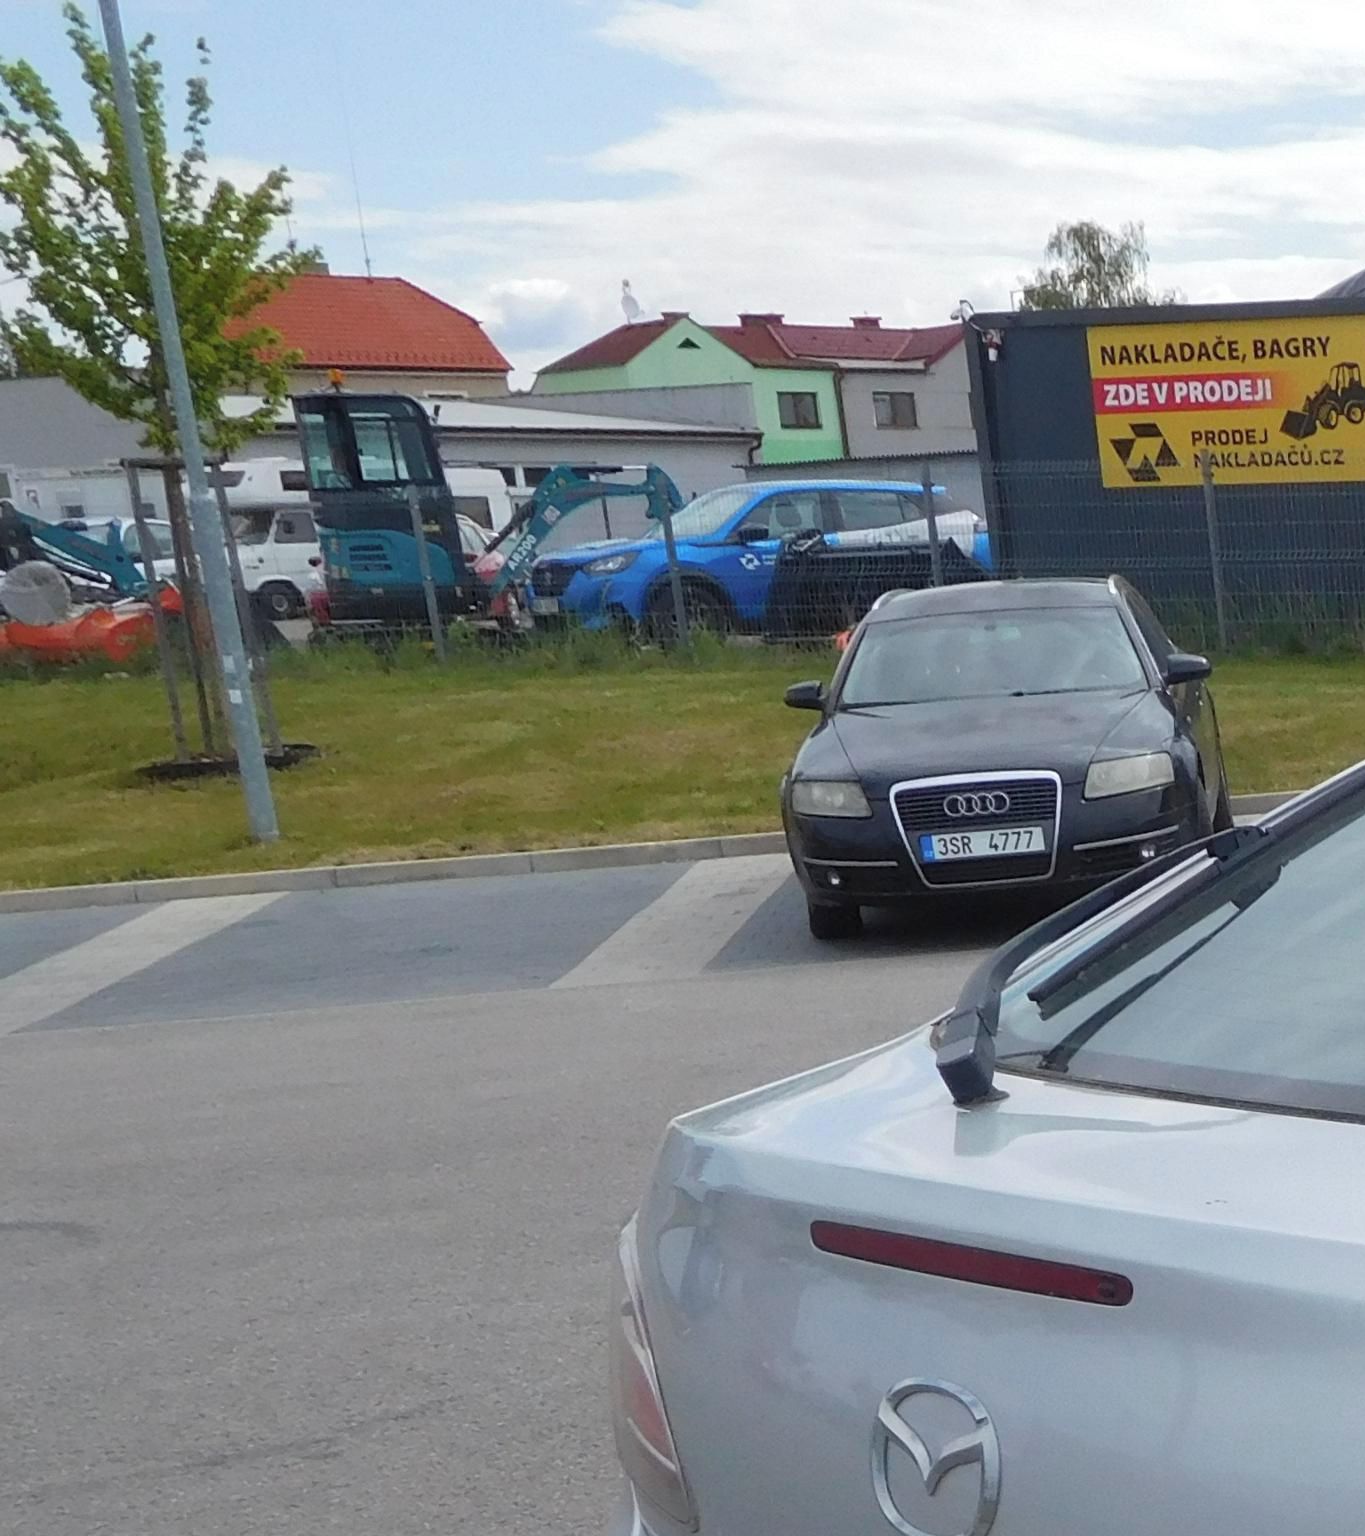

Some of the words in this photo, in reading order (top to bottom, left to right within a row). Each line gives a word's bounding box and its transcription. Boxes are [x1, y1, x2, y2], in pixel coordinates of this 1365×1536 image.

[1100, 335, 1247, 366] NAKLADAČE,
[1253, 336, 1331, 360] BAGRY
[1103, 382, 1149, 407] ZDE
[1152, 382, 1169, 404] V
[1174, 378, 1273, 403] PRODEJI
[1191, 428, 1269, 447] PRODEJ
[1193, 443, 1346, 469] NAKLADAČŮ.CZ
[937, 835, 973, 856] 3SR
[988, 830, 1033, 851] 4777
